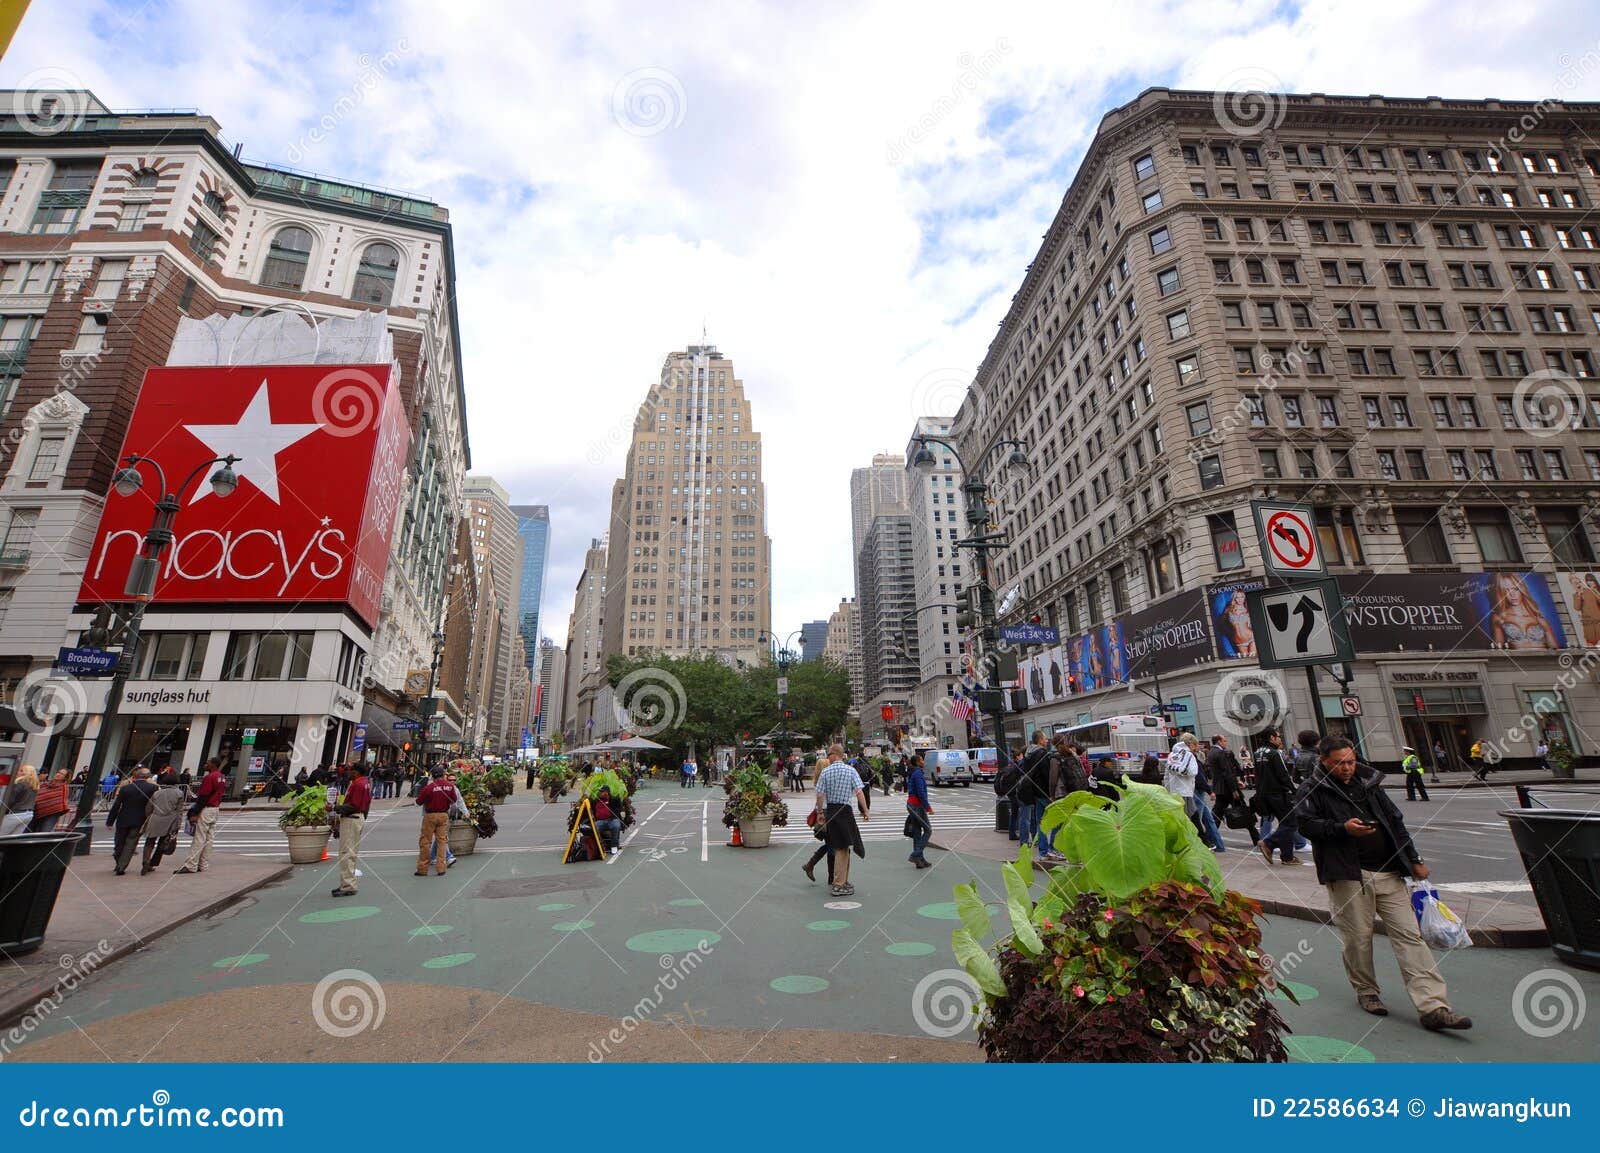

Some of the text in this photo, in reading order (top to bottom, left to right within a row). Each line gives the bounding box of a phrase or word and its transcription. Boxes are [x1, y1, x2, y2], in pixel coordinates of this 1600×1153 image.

[1005, 630, 1027, 639] West
[1045, 630, 1055, 639] St
[67, 653, 111, 667] Broadway
[1392, 672, 1479, 681] VICTORIA'S SECRET
[126, 688, 211, 706] sunglass hut
